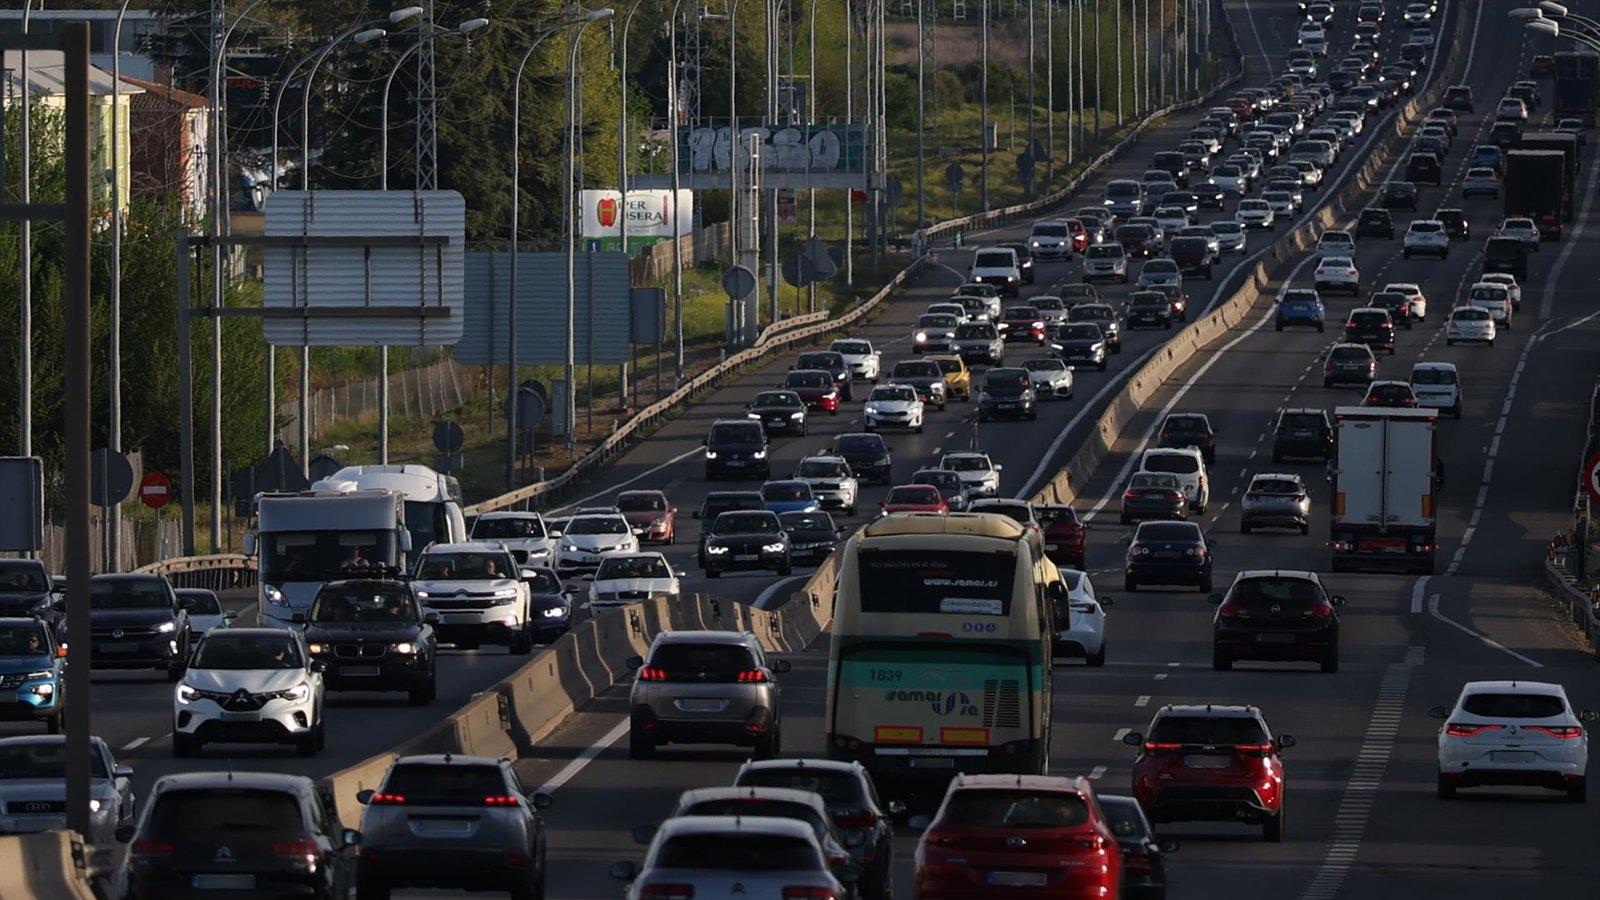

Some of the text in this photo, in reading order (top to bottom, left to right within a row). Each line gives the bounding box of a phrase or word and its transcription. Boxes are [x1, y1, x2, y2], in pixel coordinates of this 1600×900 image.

[923, 578, 999, 588] www.samar.es
[870, 670, 903, 682] 1839
[886, 691, 942, 702] samar
